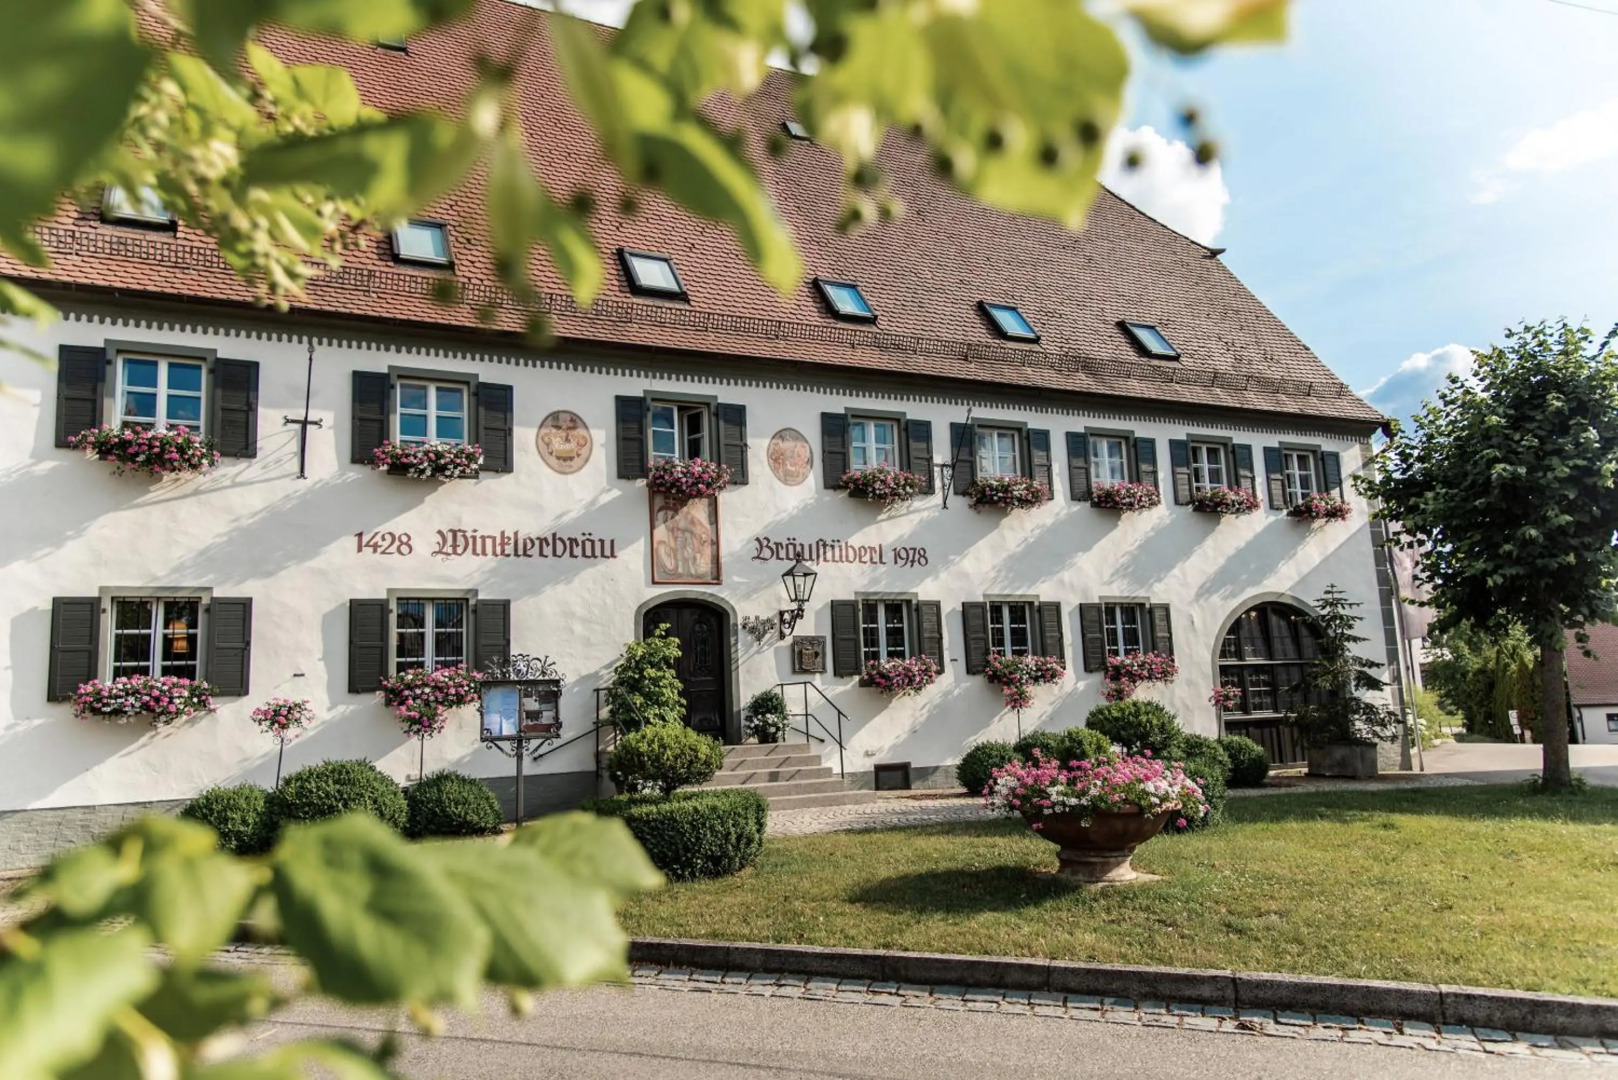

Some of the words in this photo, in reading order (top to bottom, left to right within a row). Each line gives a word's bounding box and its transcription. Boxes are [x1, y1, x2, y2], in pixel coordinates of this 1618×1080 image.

[354, 531, 412, 556] 1428
[431, 529, 618, 561] Winklerbräu
[891, 547, 929, 568] 1978
